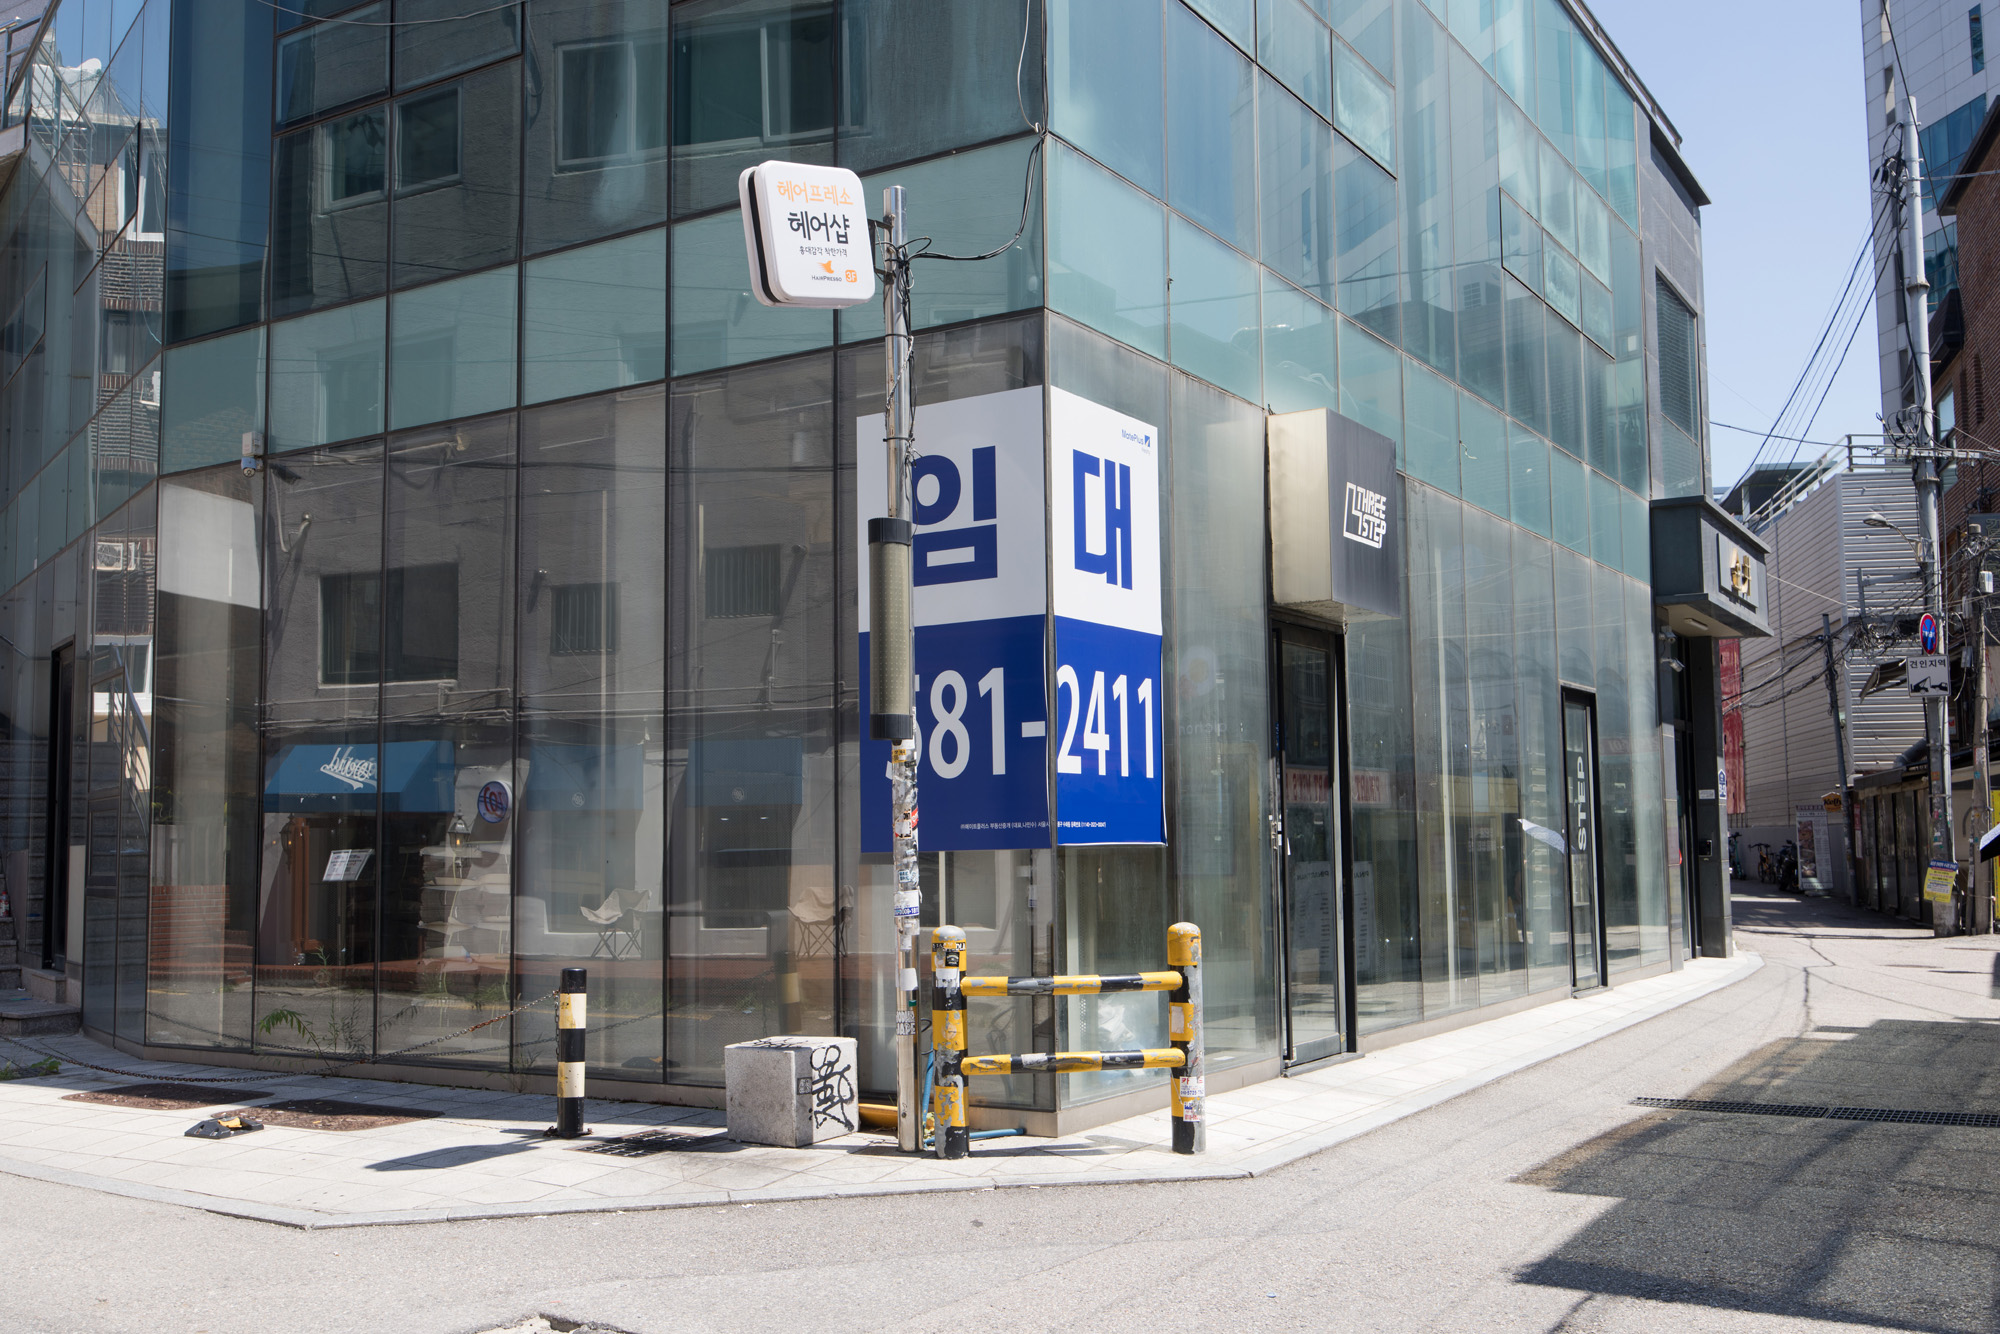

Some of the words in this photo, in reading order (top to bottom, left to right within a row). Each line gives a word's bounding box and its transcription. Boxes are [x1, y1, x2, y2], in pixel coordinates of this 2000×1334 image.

[777, 181, 853, 206] 헤어프레소
[788, 211, 850, 244] 헤어샵
[846, 271, 857, 282] 3F
[1356, 486, 1387, 519] THREE
[1909, 659, 1946, 669] 견인지역
[1577, 756, 1587, 851] STEP
